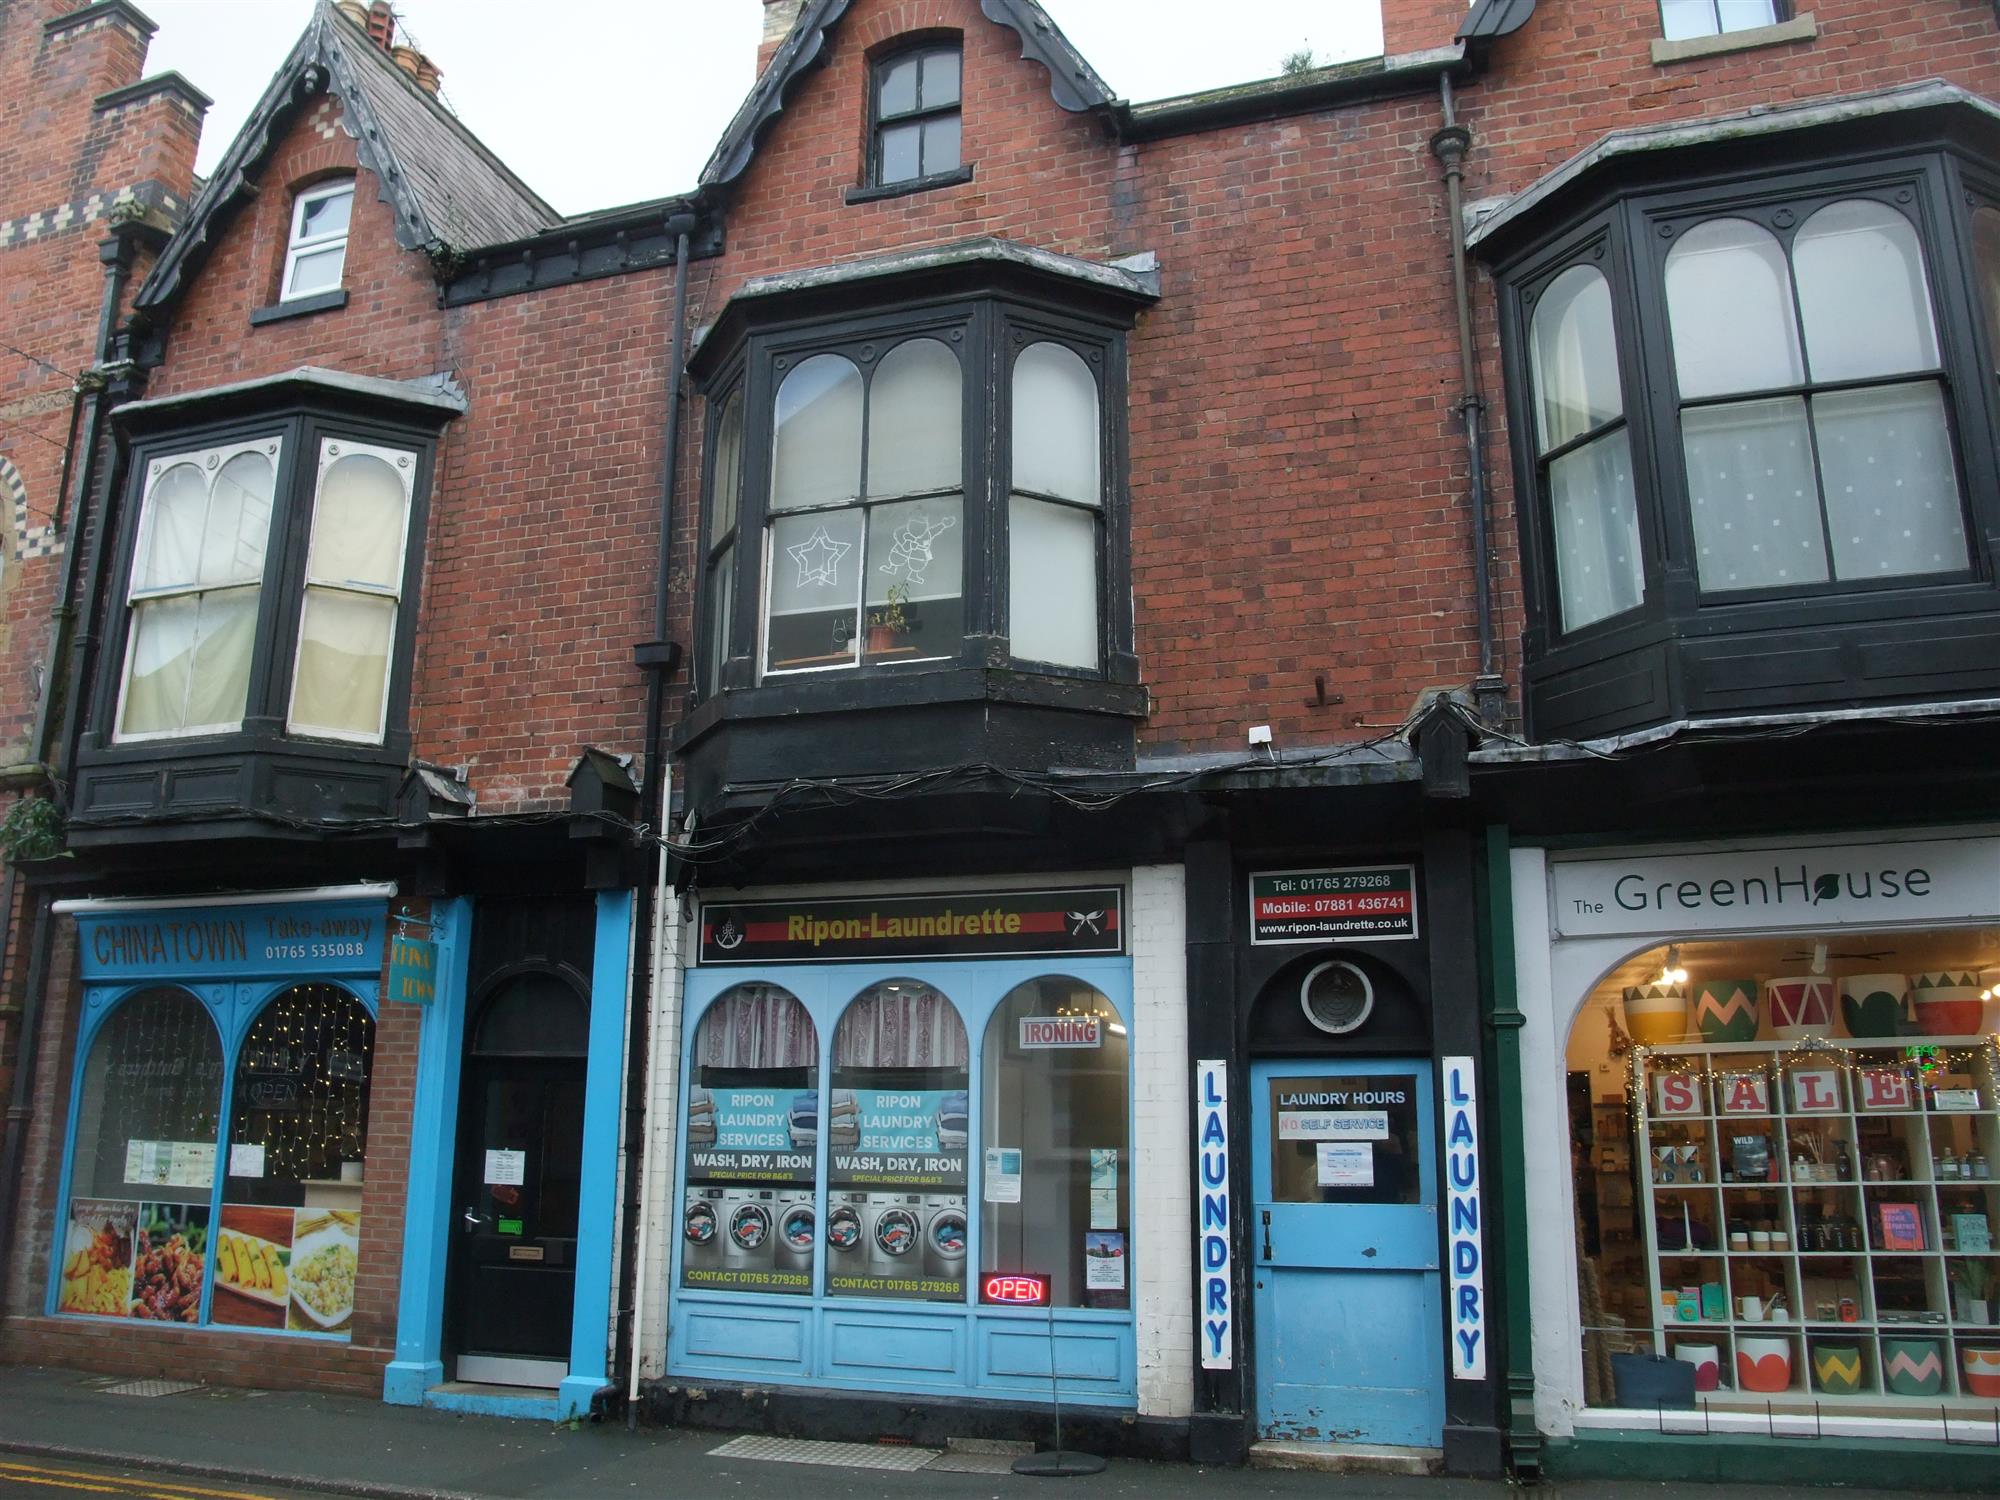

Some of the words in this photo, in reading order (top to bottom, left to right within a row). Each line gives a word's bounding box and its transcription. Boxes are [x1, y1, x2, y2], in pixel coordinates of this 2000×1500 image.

[1273, 879, 1297, 892] Tel:
[1300, 877, 1340, 890] 01765
[1343, 874, 1391, 889] 279268
[1262, 902, 1311, 914] Mobile:
[1314, 899, 1353, 912] 07881
[1357, 897, 1405, 910] 436741
[1573, 900, 1604, 914] The
[265, 915, 372, 943] Take-away
[787, 909, 1021, 946] Ripon-Laundrette
[1259, 918, 1408, 934] www.ripon-laundrette.co.uk
[93, 919, 248, 965] CHINATOWN
[265, 944, 306, 960] 01765
[311, 942, 364, 959] 535088
[1024, 1023, 1096, 1043] IRONING
[251, 1082, 297, 1102] OPEN
[1280, 1092, 1349, 1106] LAUNDRY
[1353, 1091, 1406, 1105] HOURS
[731, 1094, 774, 1108] RIPON
[876, 1095, 921, 1109] RIPON
[719, 1113, 785, 1127] LAUNDRY
[863, 1115, 933, 1129] LAUNDRY
[1280, 1118, 1298, 1130] NO
[1301, 1119, 1331, 1130] SELF
[1333, 1118, 1385, 1130] SERVICE
[719, 1133, 785, 1147] SERVICES
[862, 1135, 933, 1150] SERVICES
[1733, 1136, 1754, 1145] WILD
[693, 1153, 739, 1169] WASH,
[741, 1154, 774, 1170] DRY,
[776, 1154, 812, 1169] IRON
[835, 1155, 884, 1173] WASH,
[887, 1156, 922, 1174] DRY,
[924, 1157, 962, 1172] IRON
[708, 1170, 737, 1179] SPECIAL
[737, 1171, 757, 1179] PRICE
[757, 1171, 773, 1180] FOR
[852, 1174, 882, 1183] SPECIAL
[883, 1174, 905, 1183] PRICE
[905, 1175, 921, 1183] FOR
[1201, 1071, 1228, 1359] LAUNDRY
[1449, 1068, 1481, 1369] LAUNDRY
[687, 1270, 738, 1282] CONTACT
[739, 1271, 769, 1284] 01765
[771, 1273, 809, 1287] 279268
[831, 1277, 885, 1290] CONTACT
[887, 1278, 919, 1292] 01765
[921, 1279, 960, 1293] 279268
[986, 1279, 1042, 1300] OPEN
